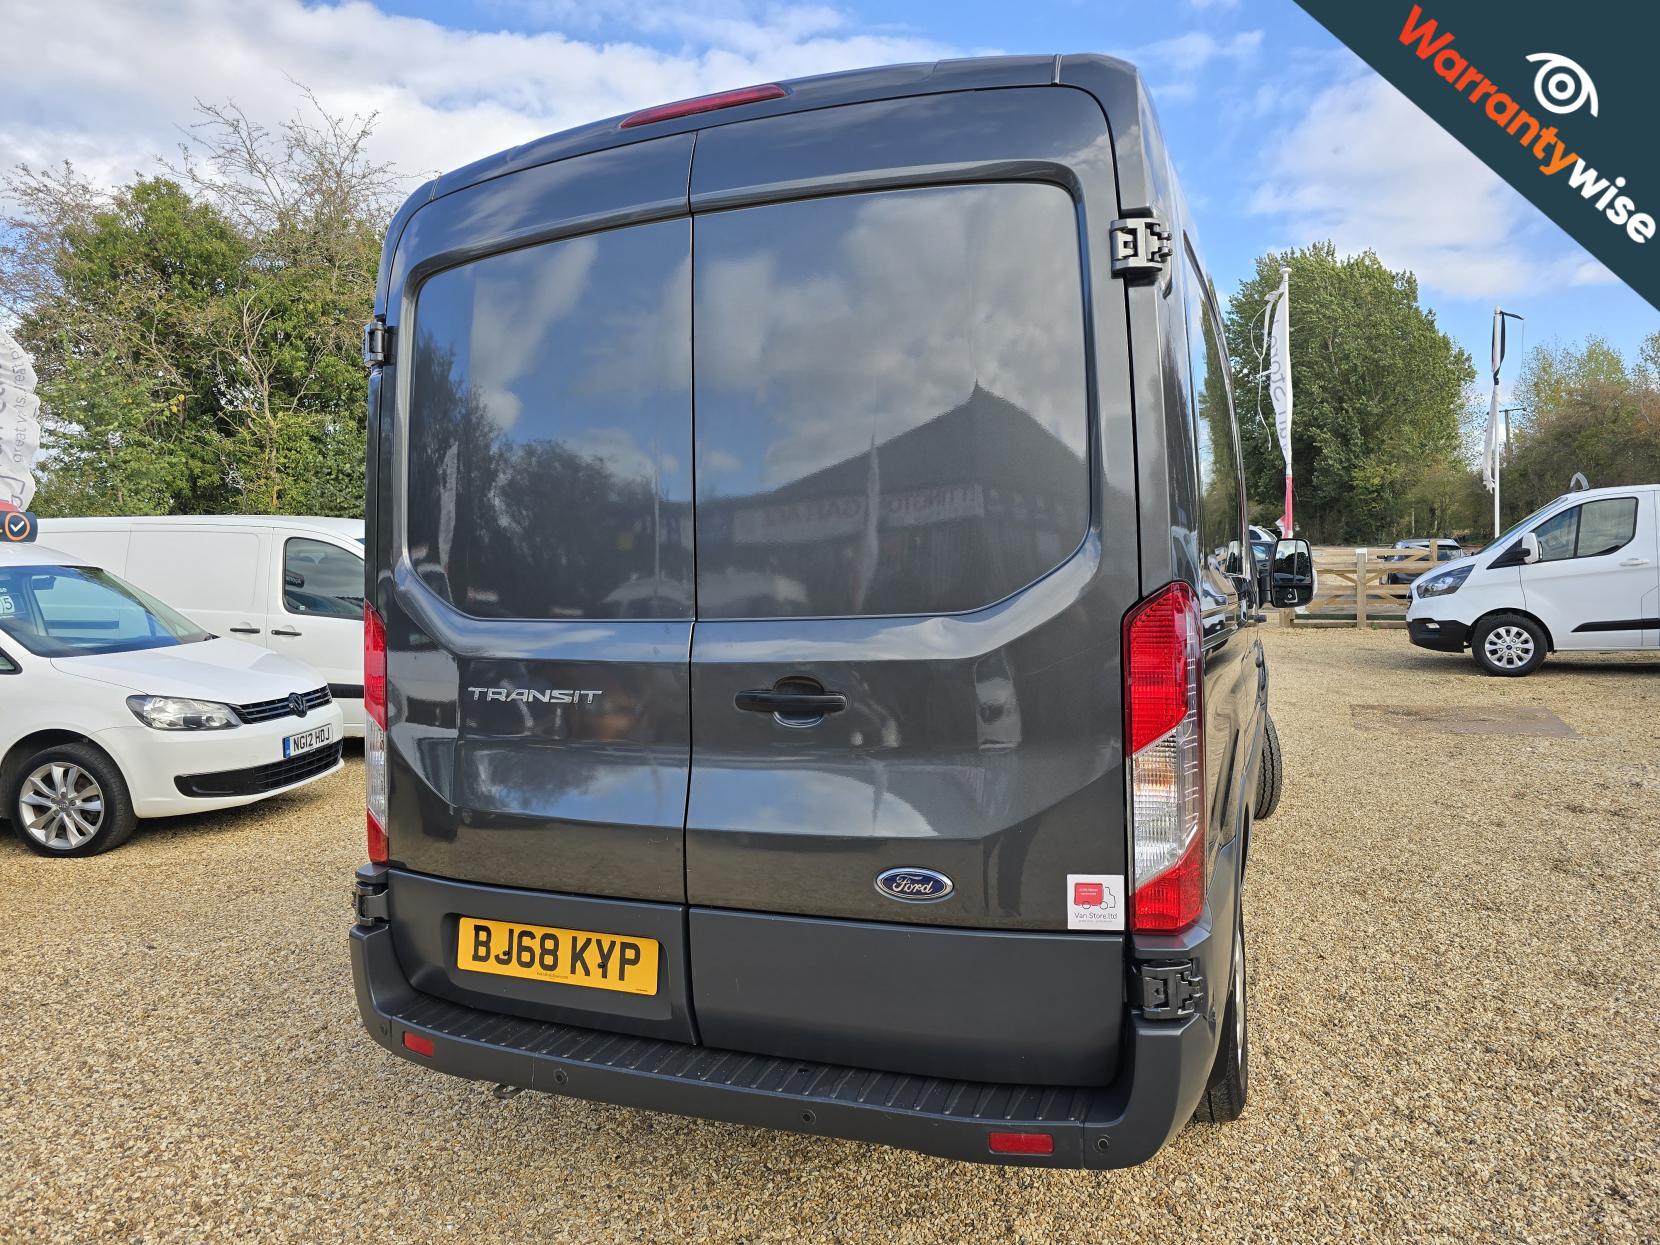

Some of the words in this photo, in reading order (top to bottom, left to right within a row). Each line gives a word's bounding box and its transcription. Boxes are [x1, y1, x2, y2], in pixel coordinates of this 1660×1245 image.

[13, 426, 27, 463] great
[467, 686, 603, 704] TRANSIT
[293, 733, 313, 752] NG12
[314, 726, 330, 745] HDJ
[892, 874, 934, 893] Ford
[472, 924, 560, 972] BJ68
[570, 935, 642, 982] KYP
